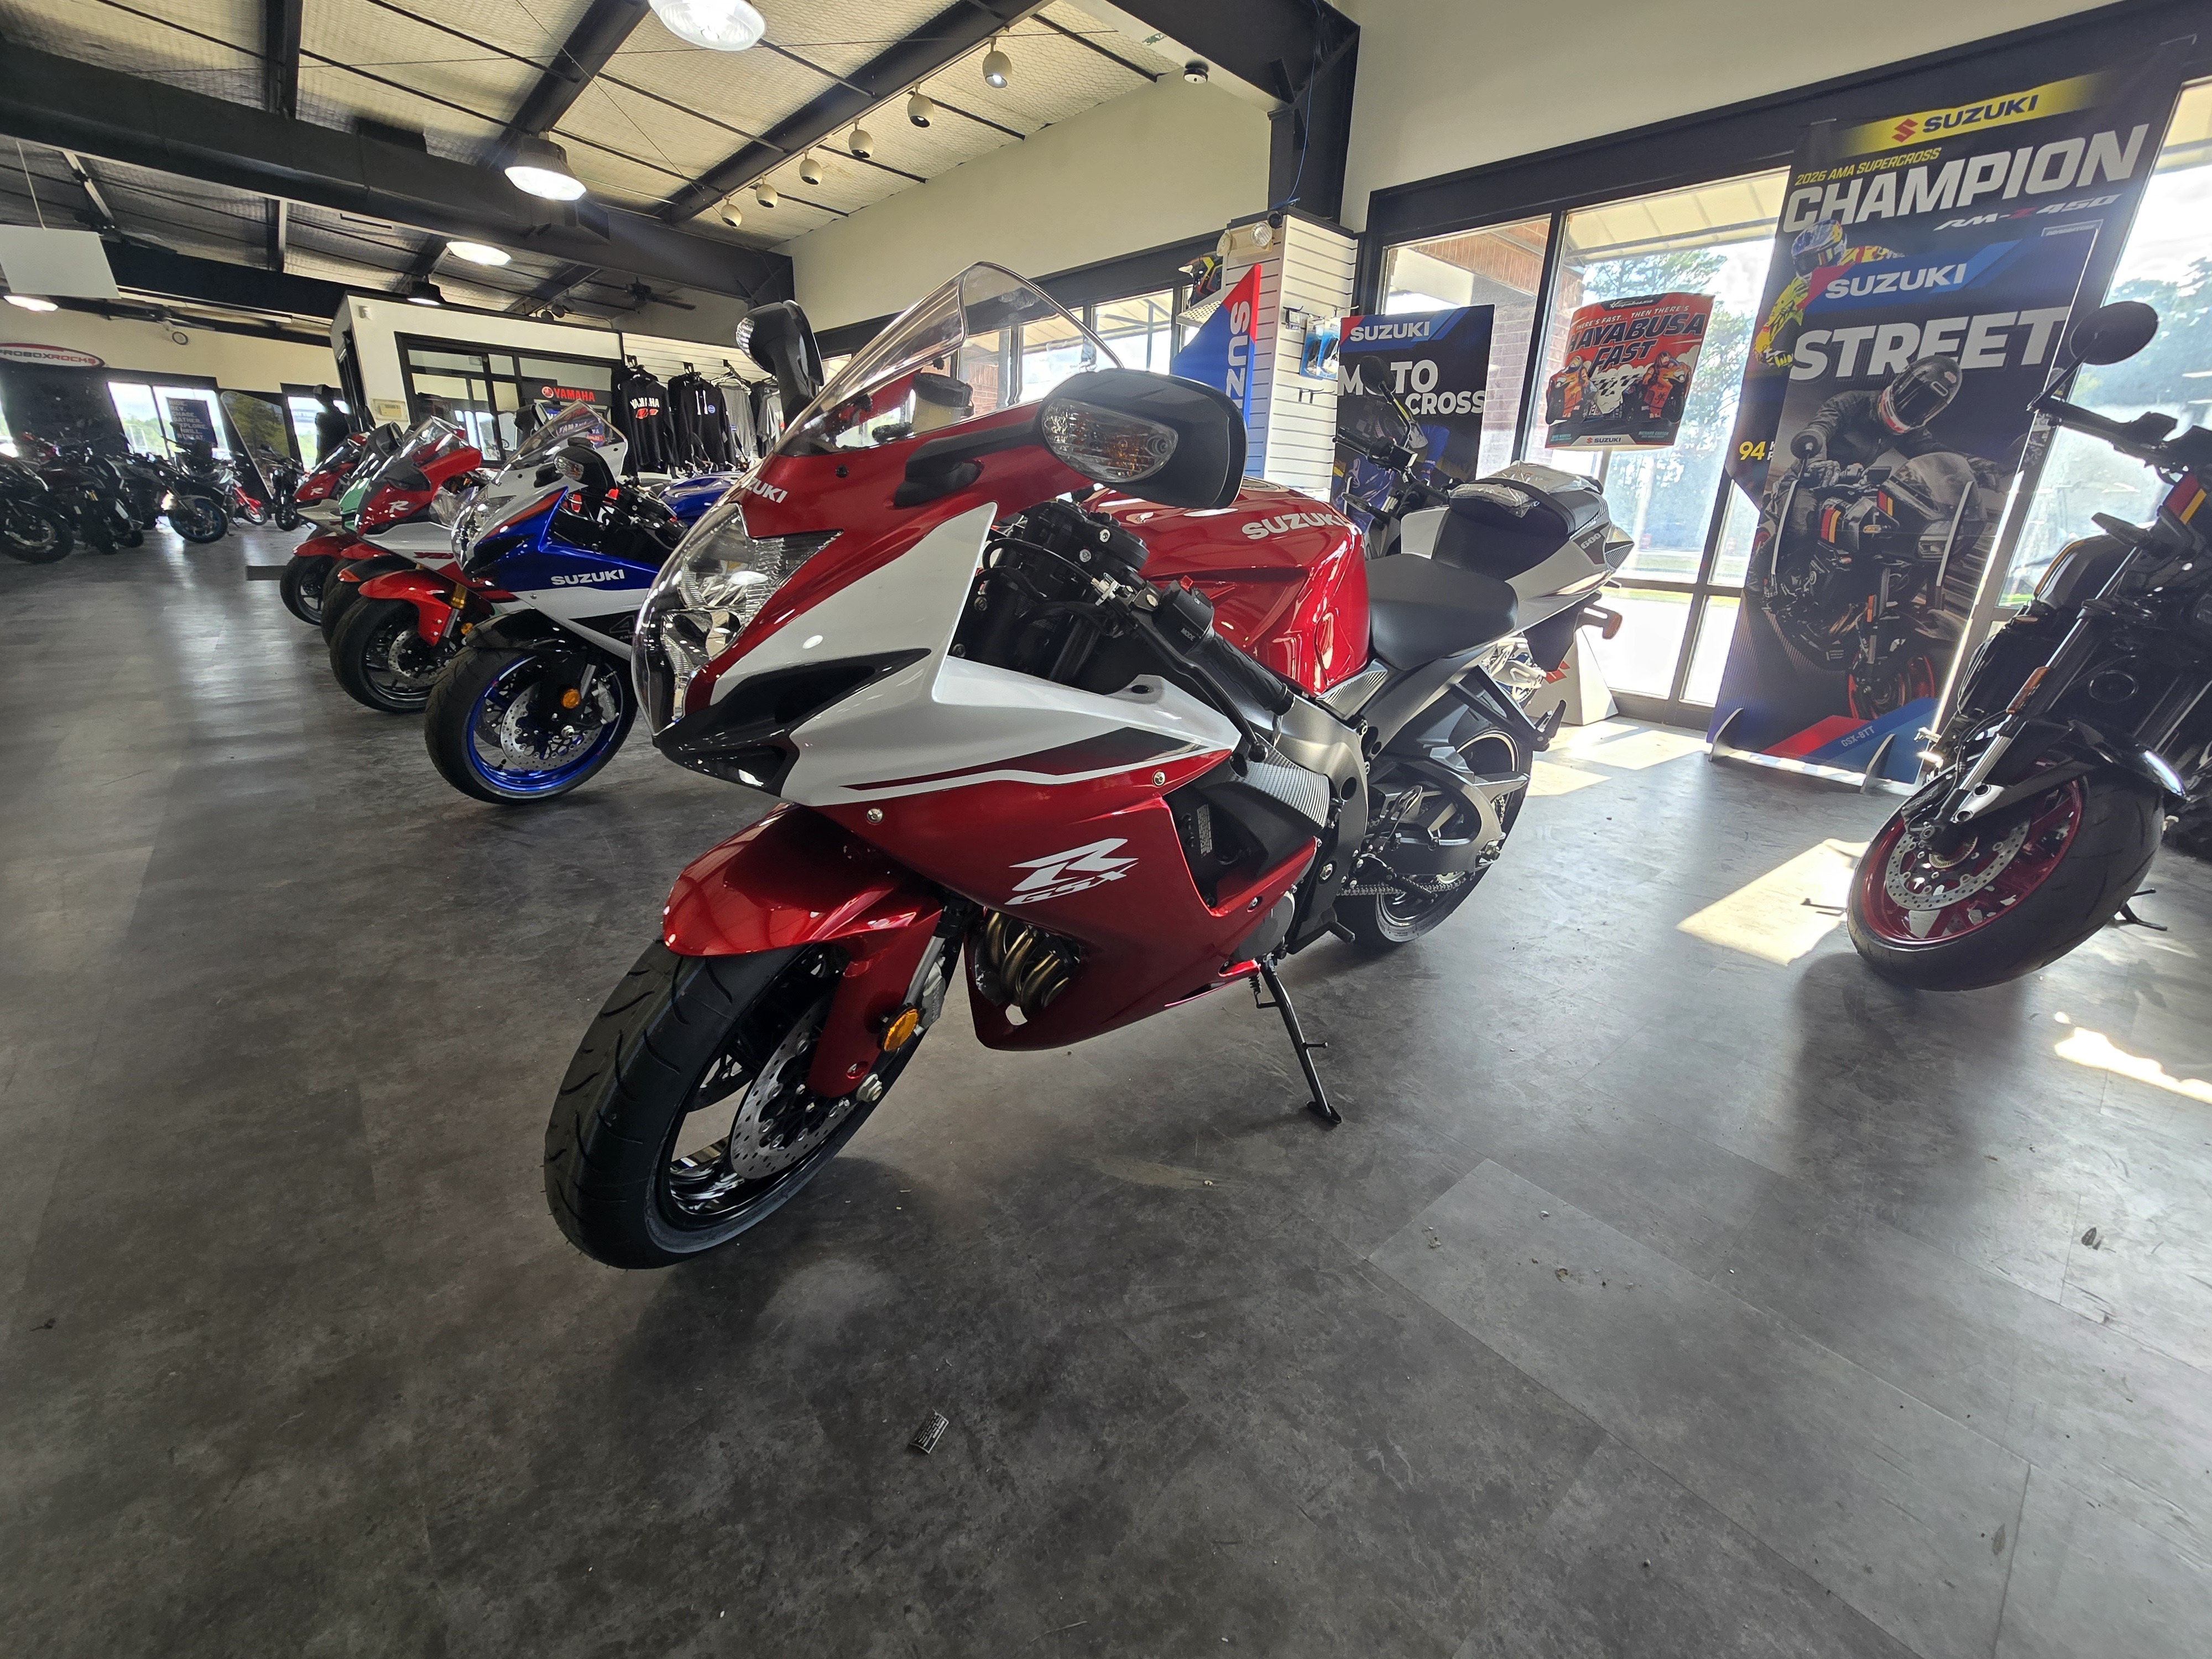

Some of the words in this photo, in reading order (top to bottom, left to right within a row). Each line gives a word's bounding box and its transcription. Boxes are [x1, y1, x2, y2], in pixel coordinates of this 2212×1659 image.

[1922, 94, 2039, 133] SUZUKI
[1783, 124, 2150, 233] CHAMPION
[1794, 170, 1827, 186] 2026
[1828, 165, 1855, 180] AMA
[1856, 147, 1942, 174] SUPERCROSS
[2036, 194, 2123, 214] 450
[1825, 263, 1967, 300] SUZUKI
[1631, 310, 1651, 319] THEN
[1350, 321, 1430, 342] SUZUKI
[1567, 312, 1707, 354] HAYABUSA
[1790, 306, 2072, 382] STREET
[1225, 301, 1250, 409] SUZ
[1587, 340, 1658, 378] FAST
[1337, 359, 1438, 396] MTO
[554, 388, 596, 402] YAMAHA
[1405, 390, 1485, 415] CROSS
[1739, 441, 1766, 460] 94
[747, 477, 788, 504] ZUKI
[1242, 513, 1347, 540] SUZUKI
[1580, 533, 1601, 549] 600
[551, 569, 625, 586] SUZUKI
[1180, 628, 1196, 641] MODE
[1841, 725, 1875, 747] GSX-8TT
